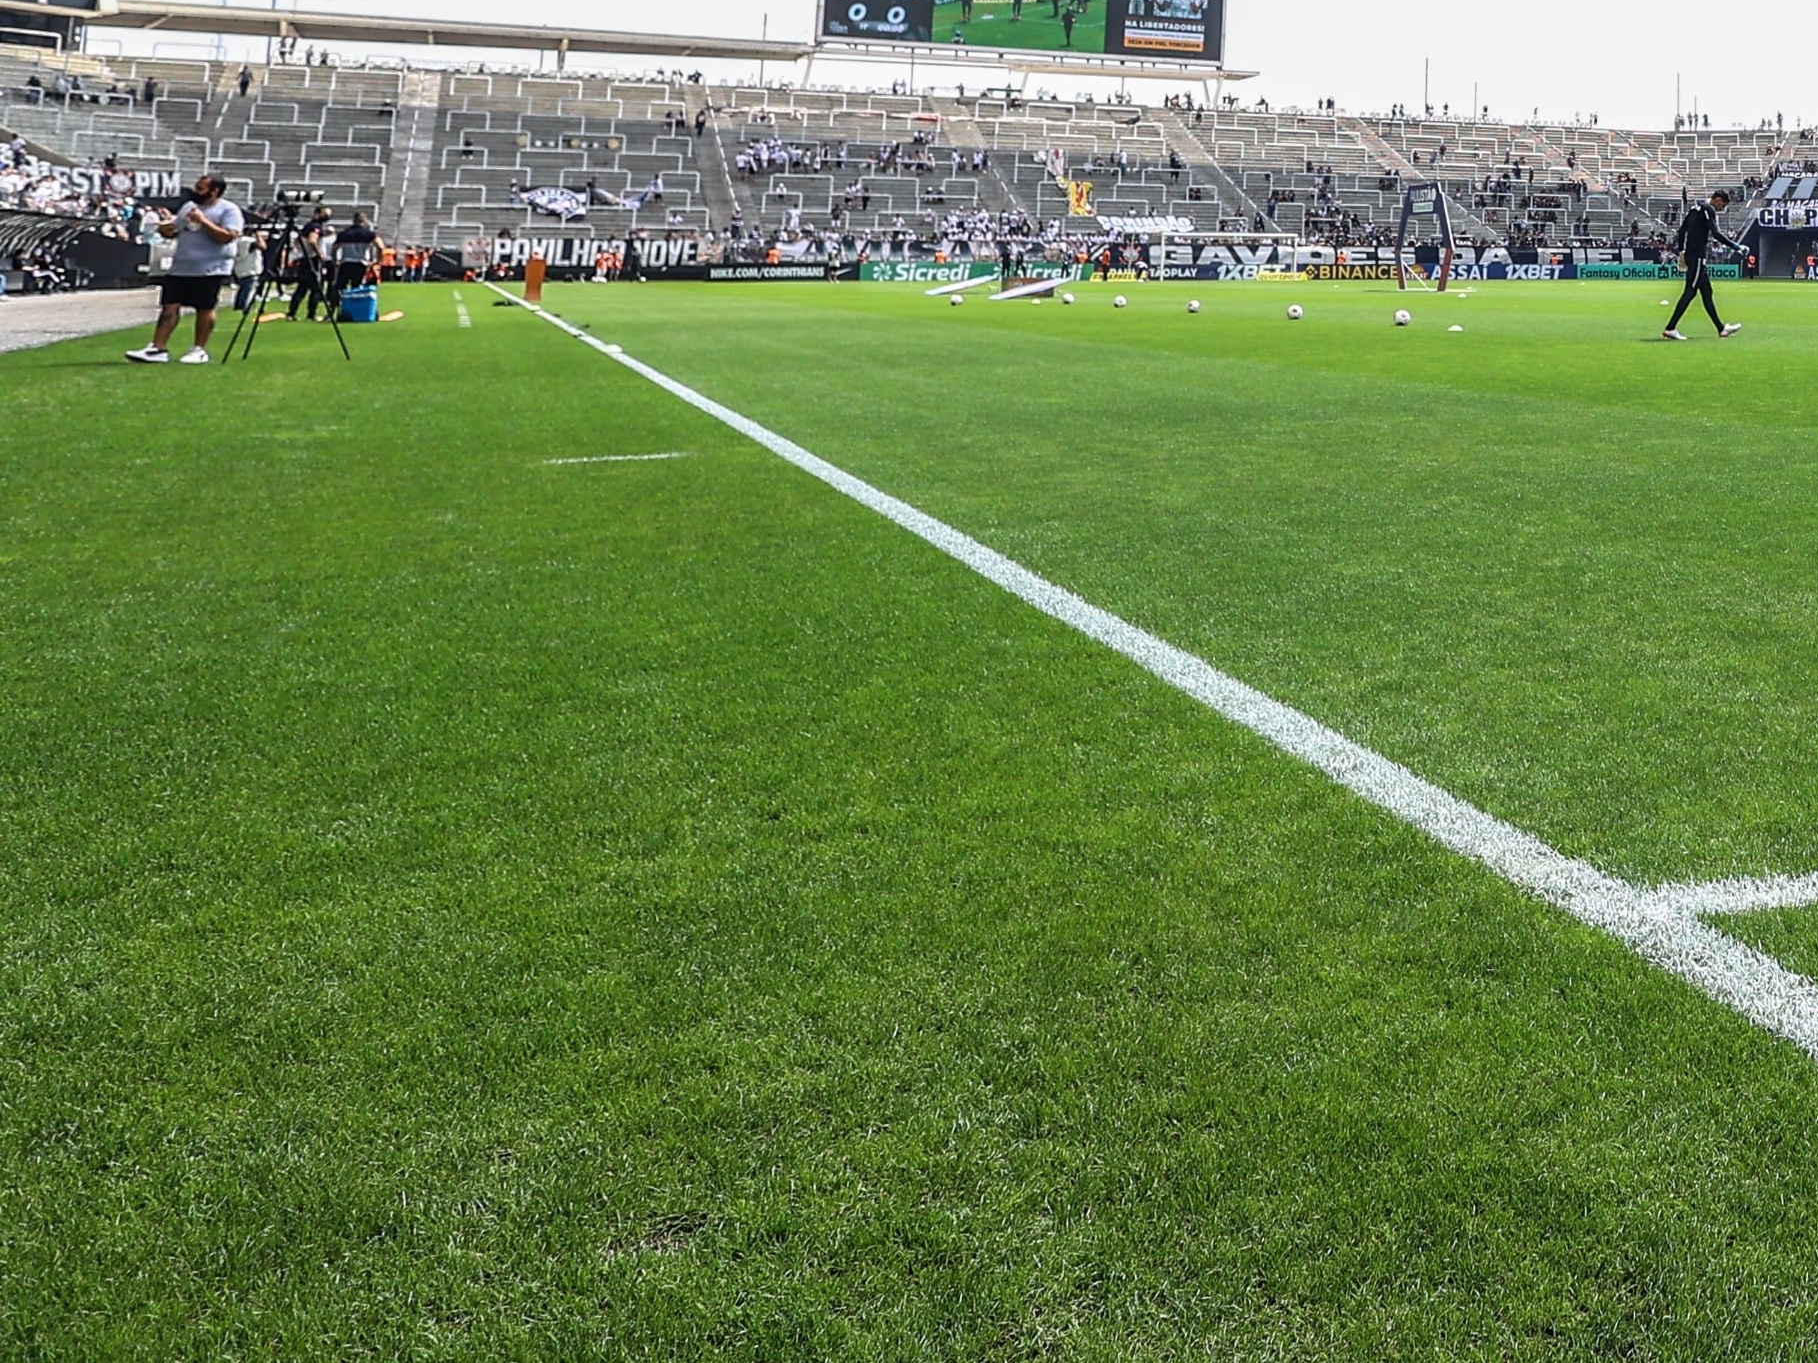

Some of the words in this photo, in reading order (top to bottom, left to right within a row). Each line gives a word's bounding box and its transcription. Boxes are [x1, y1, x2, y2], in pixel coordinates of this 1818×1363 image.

[848, 3, 866, 21] 0
[887, 6, 905, 23] 0
[1125, 20, 1138, 28] NA
[1139, 21, 1205, 33] LIBERTADORES!
[710, 267, 825, 279] NIKE.COM/CORINTHIANS
[894, 263, 971, 281] Sicredi
[1217, 264, 1286, 280] 1XBET
[1319, 266, 1398, 279] BINANCE
[1505, 265, 1564, 279] 1XBET
[1580, 267, 1620, 280] Fantasy
[1622, 267, 1656, 279] Oficial
